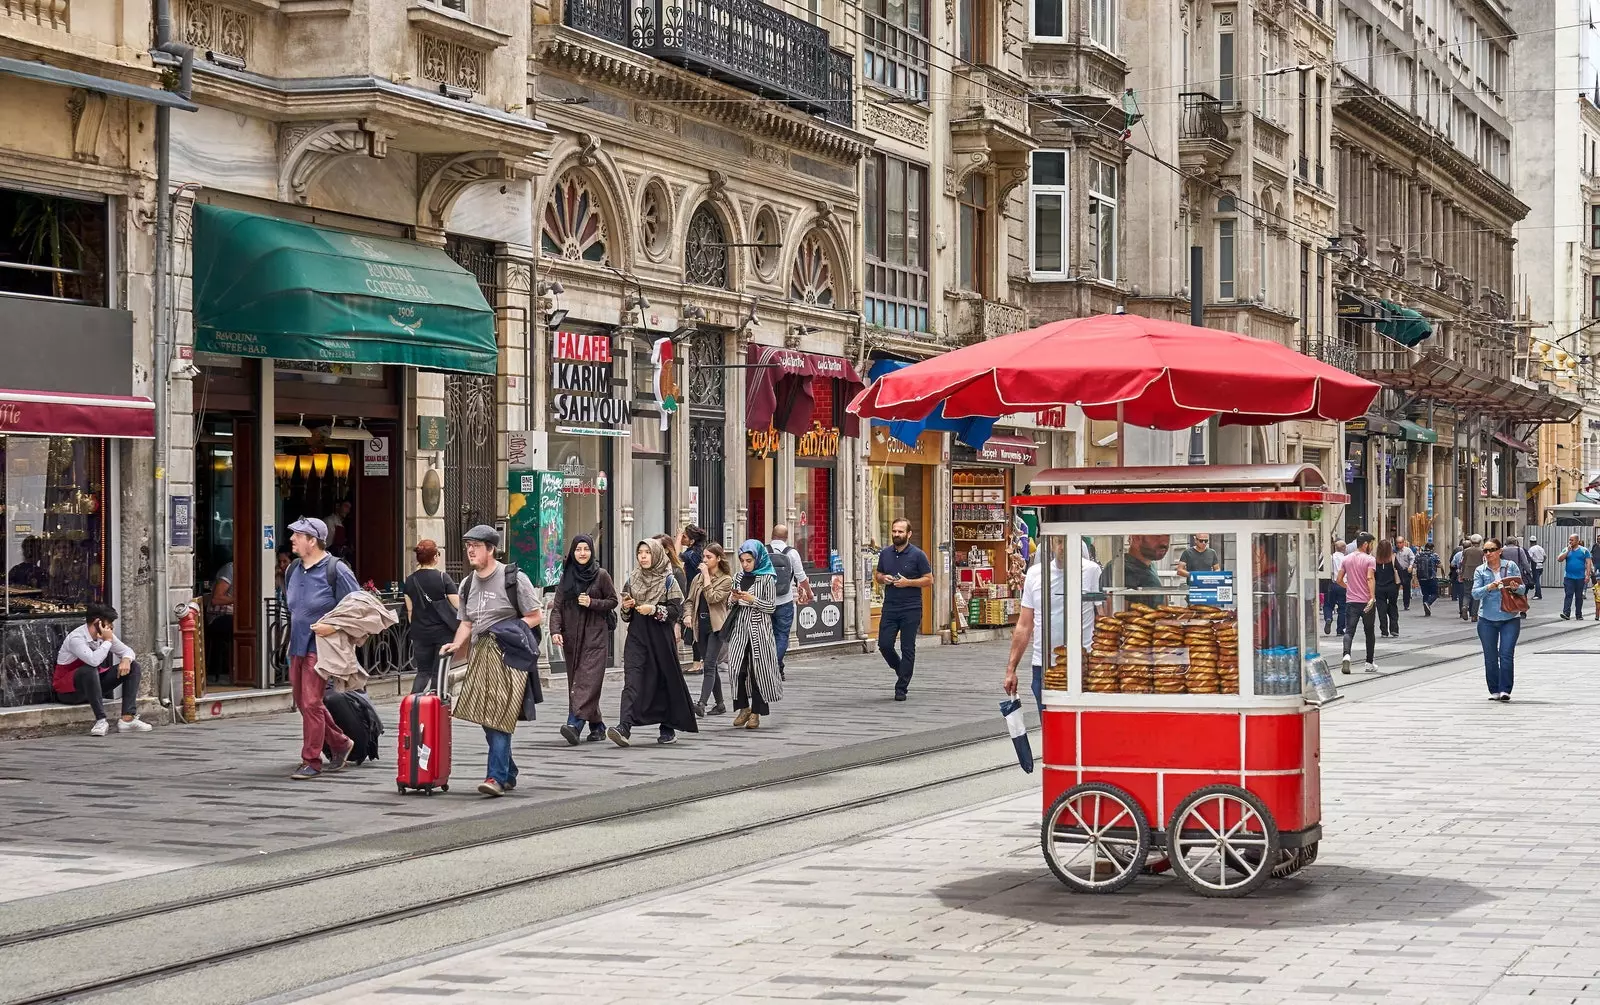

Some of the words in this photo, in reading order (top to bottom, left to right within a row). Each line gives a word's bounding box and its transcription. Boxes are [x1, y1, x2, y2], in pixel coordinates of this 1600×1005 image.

[398, 306, 415, 318] 1906
[558, 331, 612, 362] FALAFEL
[558, 362, 613, 397] KARIM
[559, 393, 632, 425] SAHYOUN
